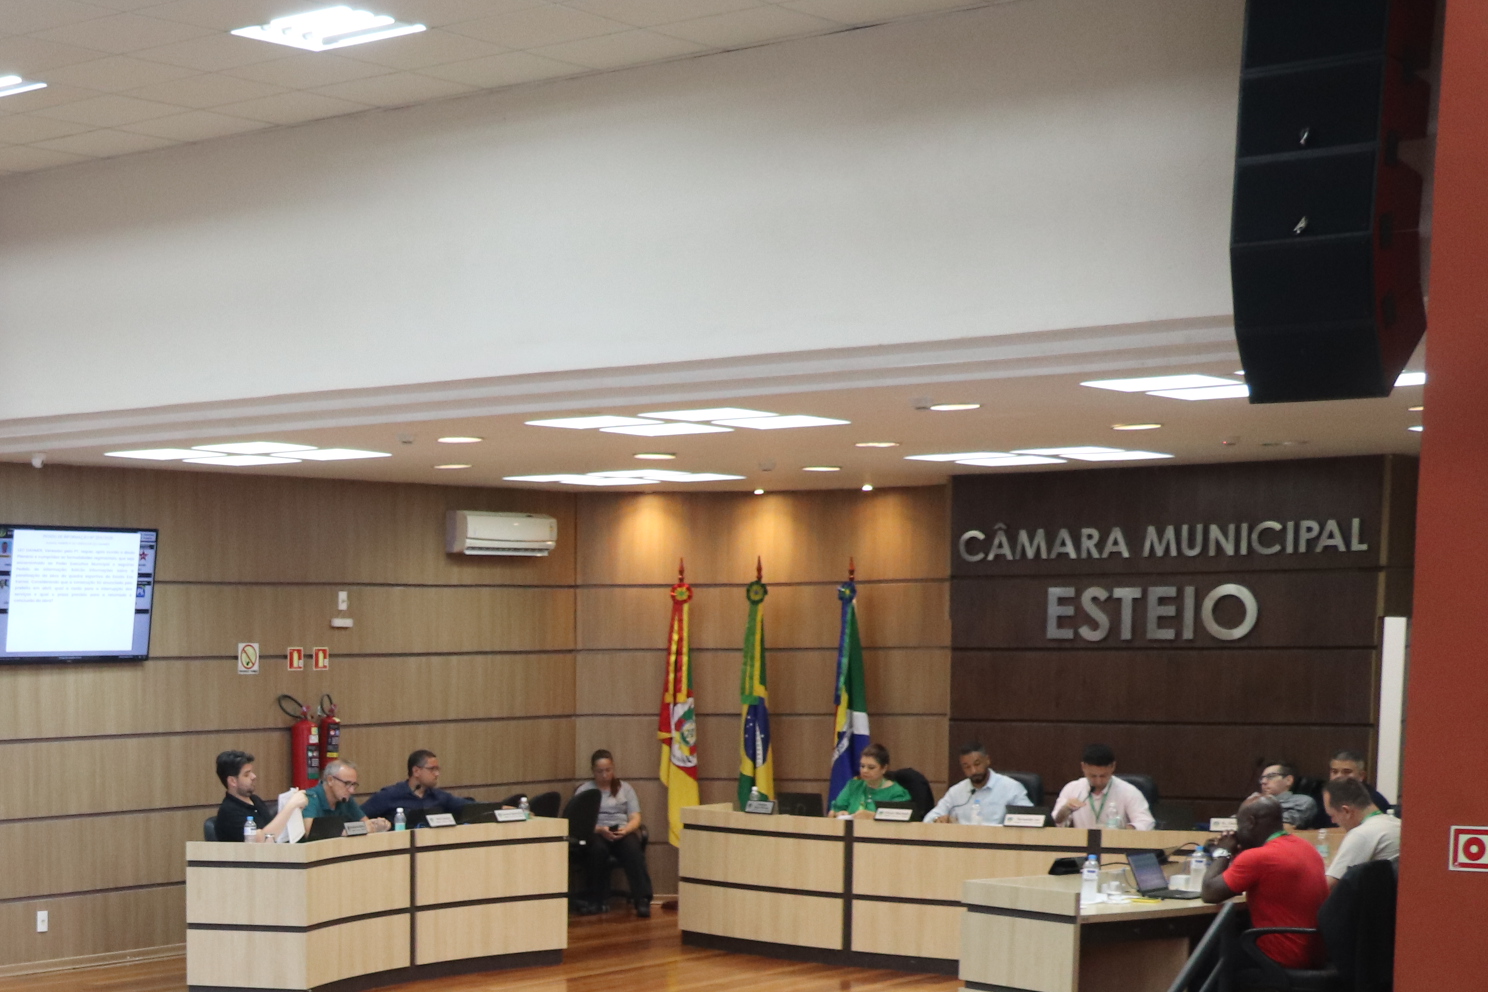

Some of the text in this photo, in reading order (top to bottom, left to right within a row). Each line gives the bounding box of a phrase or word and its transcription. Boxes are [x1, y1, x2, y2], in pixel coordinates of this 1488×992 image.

[959, 518, 1368, 562] CÂMARA MUNICIPAL
[1046, 583, 1258, 642] ESTEIO
